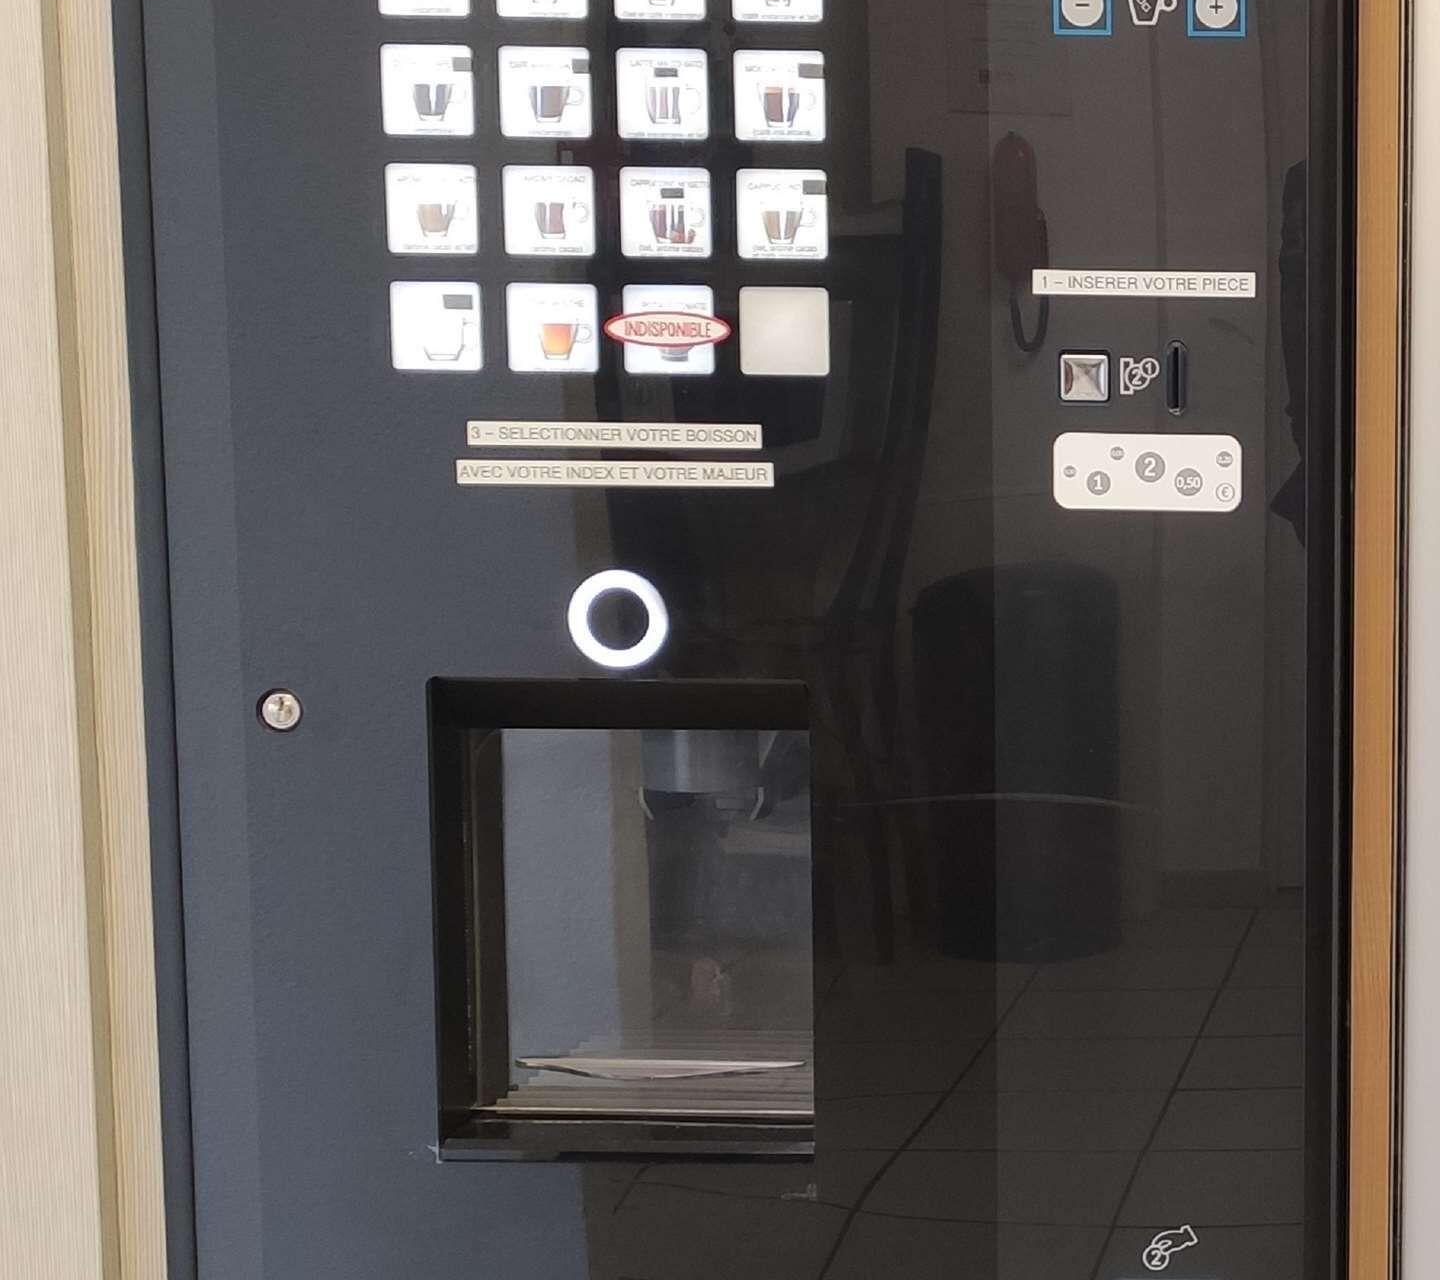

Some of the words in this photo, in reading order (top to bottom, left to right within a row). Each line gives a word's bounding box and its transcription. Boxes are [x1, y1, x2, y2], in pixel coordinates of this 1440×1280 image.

[1042, 276, 1047, 288] 1
[1068, 276, 1138, 289] INSERER
[1143, 277, 1197, 290] VOTRE
[1202, 278, 1249, 291] PIECE
[624, 322, 712, 337] INDISPONIBLE
[471, 426, 481, 439] 3
[499, 426, 622, 441] SELECTIONNER
[628, 428, 681, 441] VOTRE
[686, 428, 757, 443] BOISSON
[459, 465, 503, 479] AVEC
[507, 465, 562, 479] VOTRE
[567, 466, 615, 480] INDEX
[619, 467, 639, 480] ET
[645, 467, 698, 480] VOTRE
[702, 467, 768, 481] MAJEUR
[1143, 457, 1156, 477] 2
[1093, 475, 1103, 490] 1
[1177, 475, 1201, 490] 0,50
